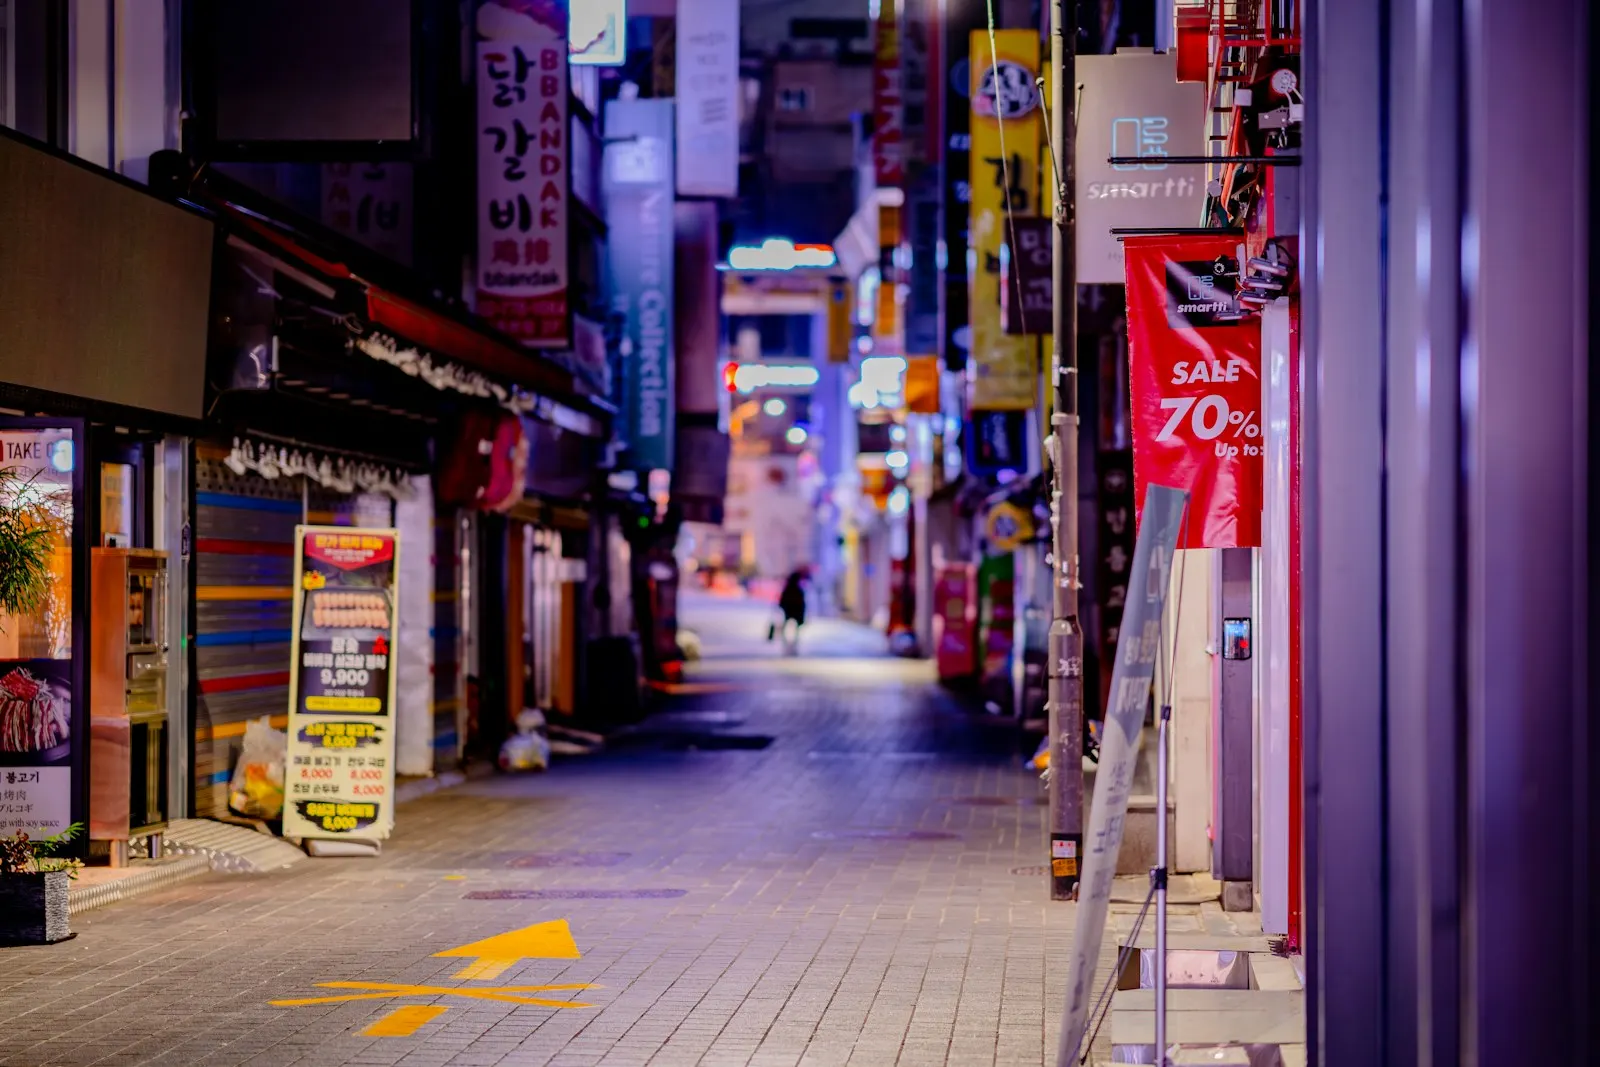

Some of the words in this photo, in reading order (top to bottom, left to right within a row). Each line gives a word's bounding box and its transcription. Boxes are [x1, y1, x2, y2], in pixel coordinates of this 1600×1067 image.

[484, 46, 536, 231] 닭갈비
[540, 48, 561, 229] BBANDAK
[1086, 176, 1196, 200] smartti
[1177, 301, 1228, 313] smartti
[1170, 359, 1241, 385] SALE
[1154, 394, 1260, 442] 70%
[6, 442, 41, 459] TAKE
[1214, 442, 1239, 461] Up
[320, 668, 369, 687] 9,900
[6, 771, 40, 784] 불고기
[0, 789, 27, 801] 烤肉
[8, 818, 25, 828] with
[26, 820, 38, 829] soy
